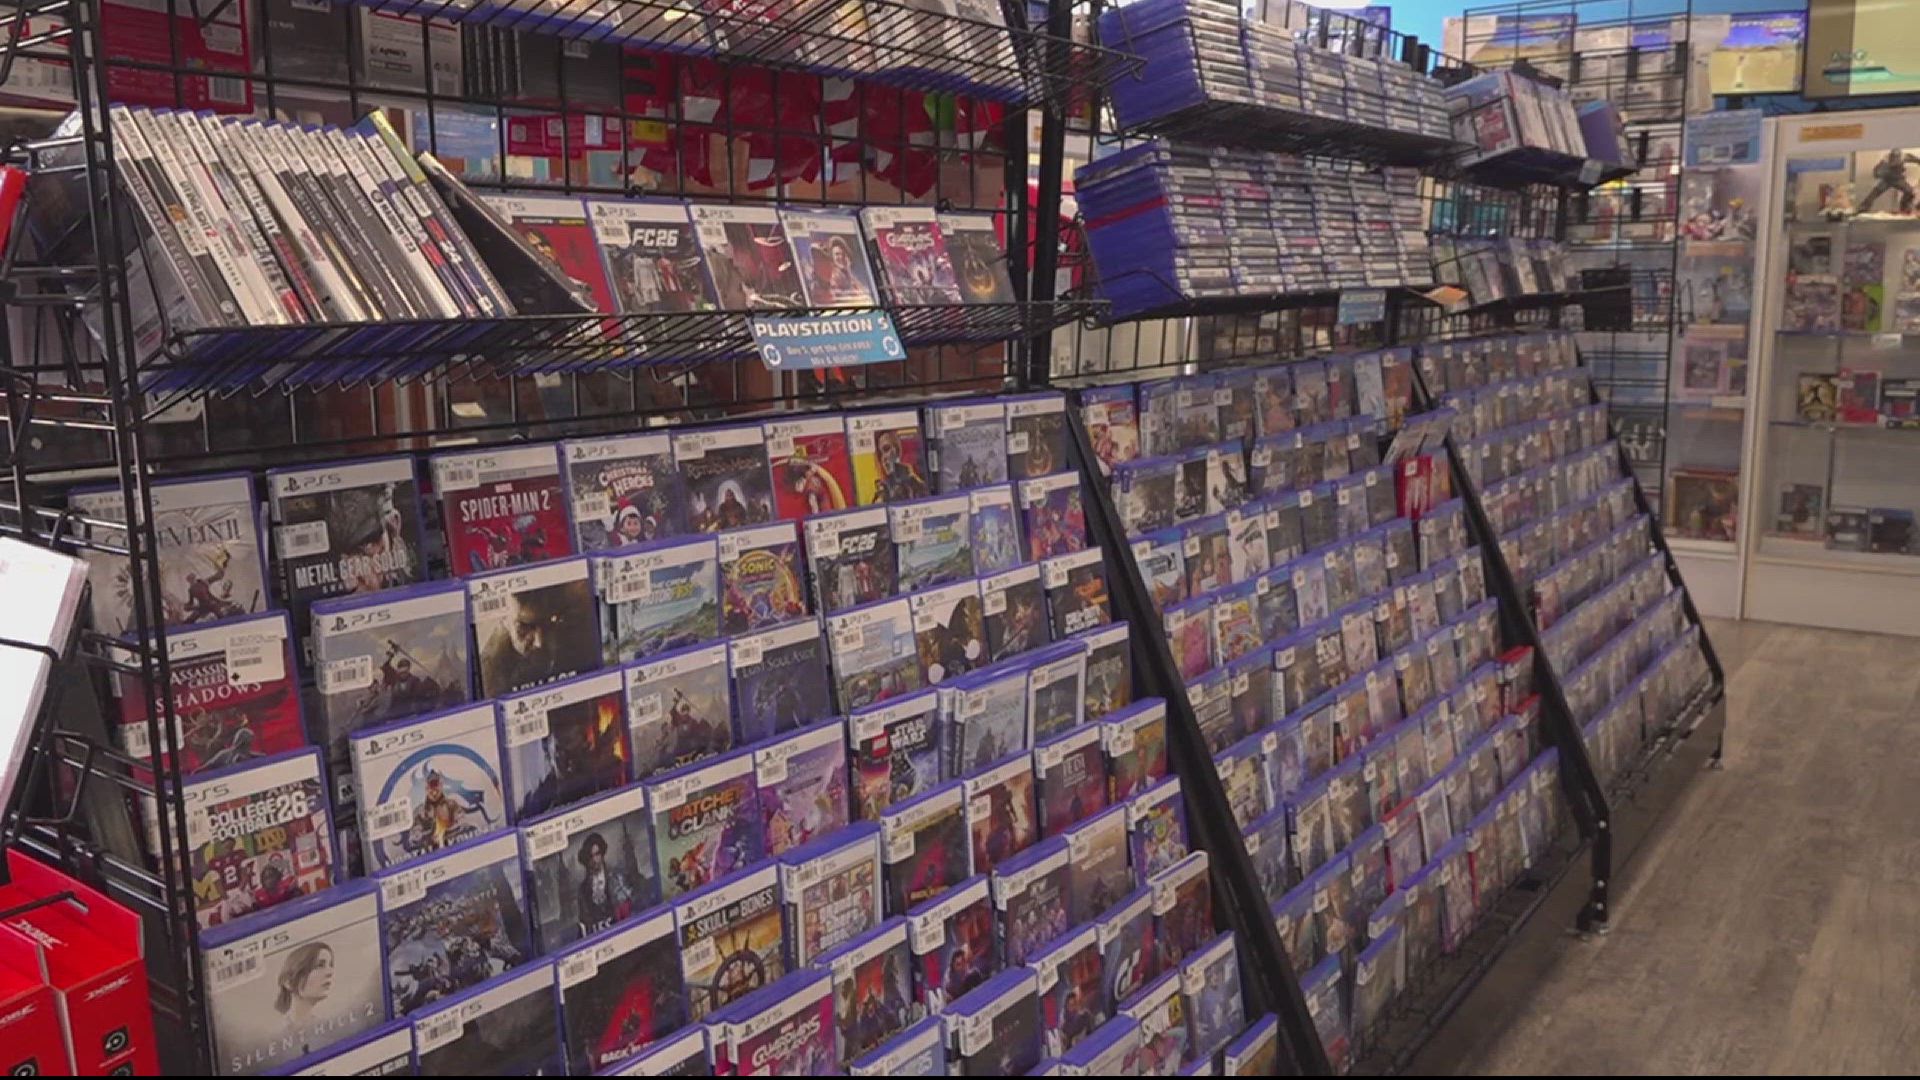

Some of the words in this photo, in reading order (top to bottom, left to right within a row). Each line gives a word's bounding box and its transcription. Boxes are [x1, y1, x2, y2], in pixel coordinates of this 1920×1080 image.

[631, 228, 680, 247] FC26
[754, 319, 873, 337] PLAYSTATION
[877, 316, 889, 331] 5
[303, 472, 342, 487] PS5
[612, 475, 655, 497] HEROES
[460, 489, 540, 523] SPIDER-MAN
[540, 489, 552, 511] 2
[295, 561, 338, 589] METAL
[338, 553, 374, 582] GEAR
[739, 560, 776, 576] SONIC
[352, 608, 392, 625] PS5
[386, 729, 425, 749] PS5
[207, 797, 277, 830] COLLEGE
[277, 790, 309, 822] 26
[680, 804, 738, 832] CLANK
[696, 908, 730, 938] SKULL
[740, 888, 774, 918] BONES
[231, 1030, 308, 1073] SILENT
[314, 1014, 358, 1037] HILL
[364, 1002, 375, 1018] 2
